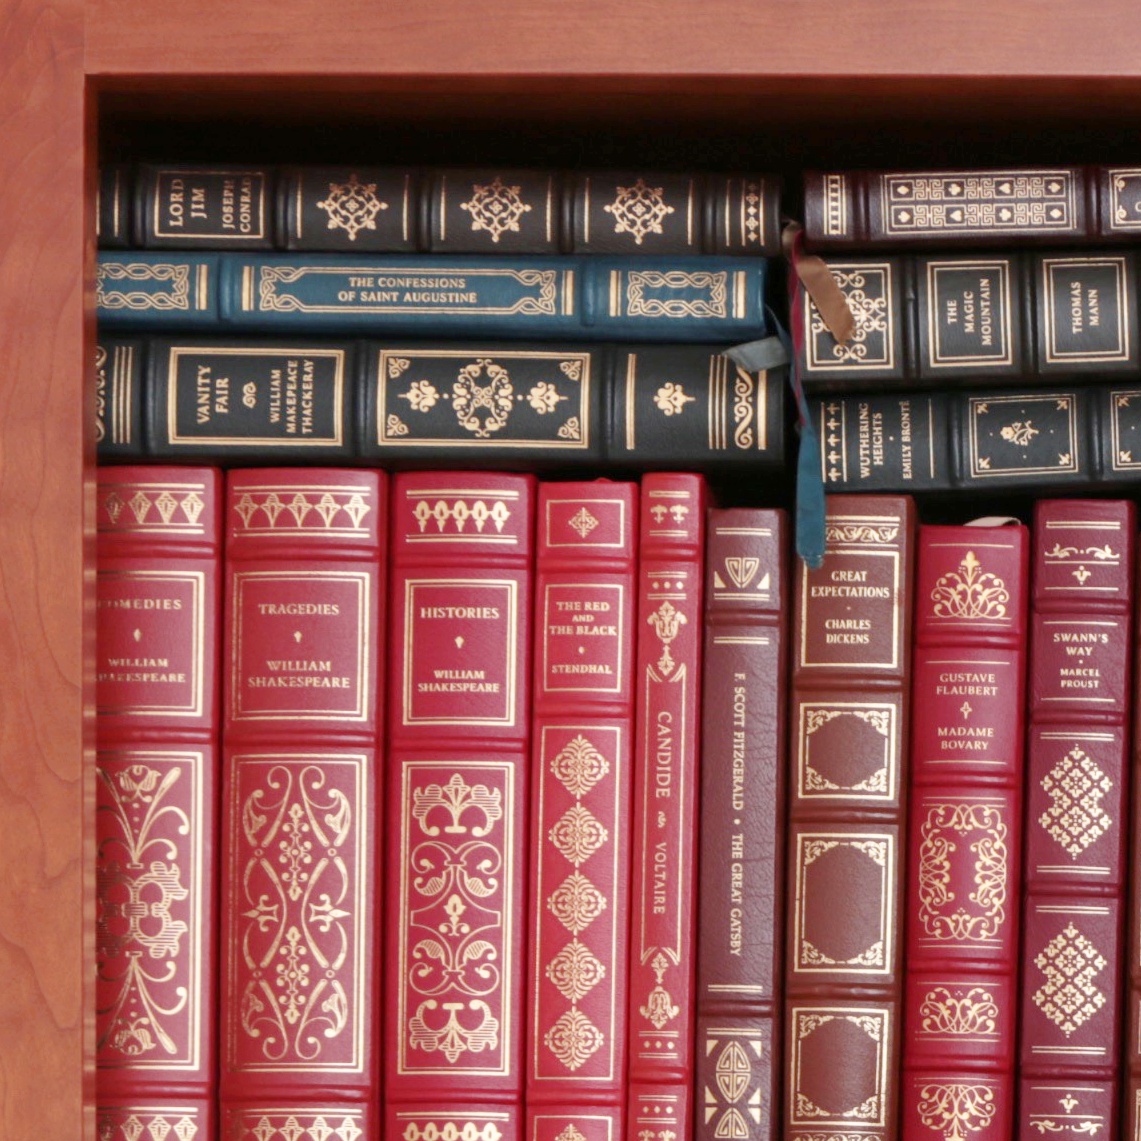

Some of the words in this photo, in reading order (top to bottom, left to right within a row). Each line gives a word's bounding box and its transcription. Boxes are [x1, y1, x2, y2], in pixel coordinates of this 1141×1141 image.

[169, 179, 184, 227] LORD
[190, 188, 207, 218] JIM
[349, 277, 374, 288] THE
[378, 278, 466, 288] CONFESSIONS
[338, 291, 357, 302] OF
[360, 291, 399, 302] SAINT
[403, 292, 477, 303] AUGUSTINE
[948, 299, 957, 324] THE
[964, 290, 974, 332] MAGIC
[981, 278, 991, 346] MOUNTAIN
[1072, 281, 1082, 333] THOMAS
[1089, 289, 1099, 326] MANN
[197, 365, 211, 424] VANITY
[215, 378, 229, 414] FAIR
[270, 369, 280, 423] WILLIAM
[287, 360, 298, 433] MAKEPEACE
[302, 359, 314, 434] THACKERAY
[831, 571, 867, 582] GREAT
[811, 586, 890, 598] EXPECTATIONS
[258, 604, 339, 615] TRAGEDIES
[420, 607, 499, 619] HISTORIES
[557, 602, 581, 612] THE
[584, 602, 610, 612] RED
[572, 614, 594, 622] AND
[825, 619, 871, 629] CHARLES
[550, 625, 573, 635] THE
[576, 626, 617, 636] BLACK
[826, 634, 869, 644] DICKENS
[1053, 632, 1108, 643] SWANN'S
[1066, 646, 1092, 656] WAY
[267, 661, 331, 672] WILLIAM
[552, 664, 612, 674] STENDHAL
[1060, 668, 1101, 677] MARCEL
[434, 670, 485, 680] WILLIAM
[940, 672, 996, 683] GUSTAVE
[248, 676, 350, 688] SHAKESPEARE
[418, 682, 500, 692] SHAKESPEARE
[1060, 680, 1099, 688] PROUST
[936, 685, 998, 695] FLAUBERT
[733, 687, 746, 728] SCOTT
[938, 727, 994, 737] MADAME
[941, 740, 989, 750] BOVARY
[656, 711, 672, 798] CANDIDE
[731, 732, 745, 810] FITZGERALD
[731, 834, 743, 859] THE
[653, 843, 667, 914] VOLTAIRE
[731, 863, 743, 904] GREAT
[730, 908, 742, 956] GATSBY
